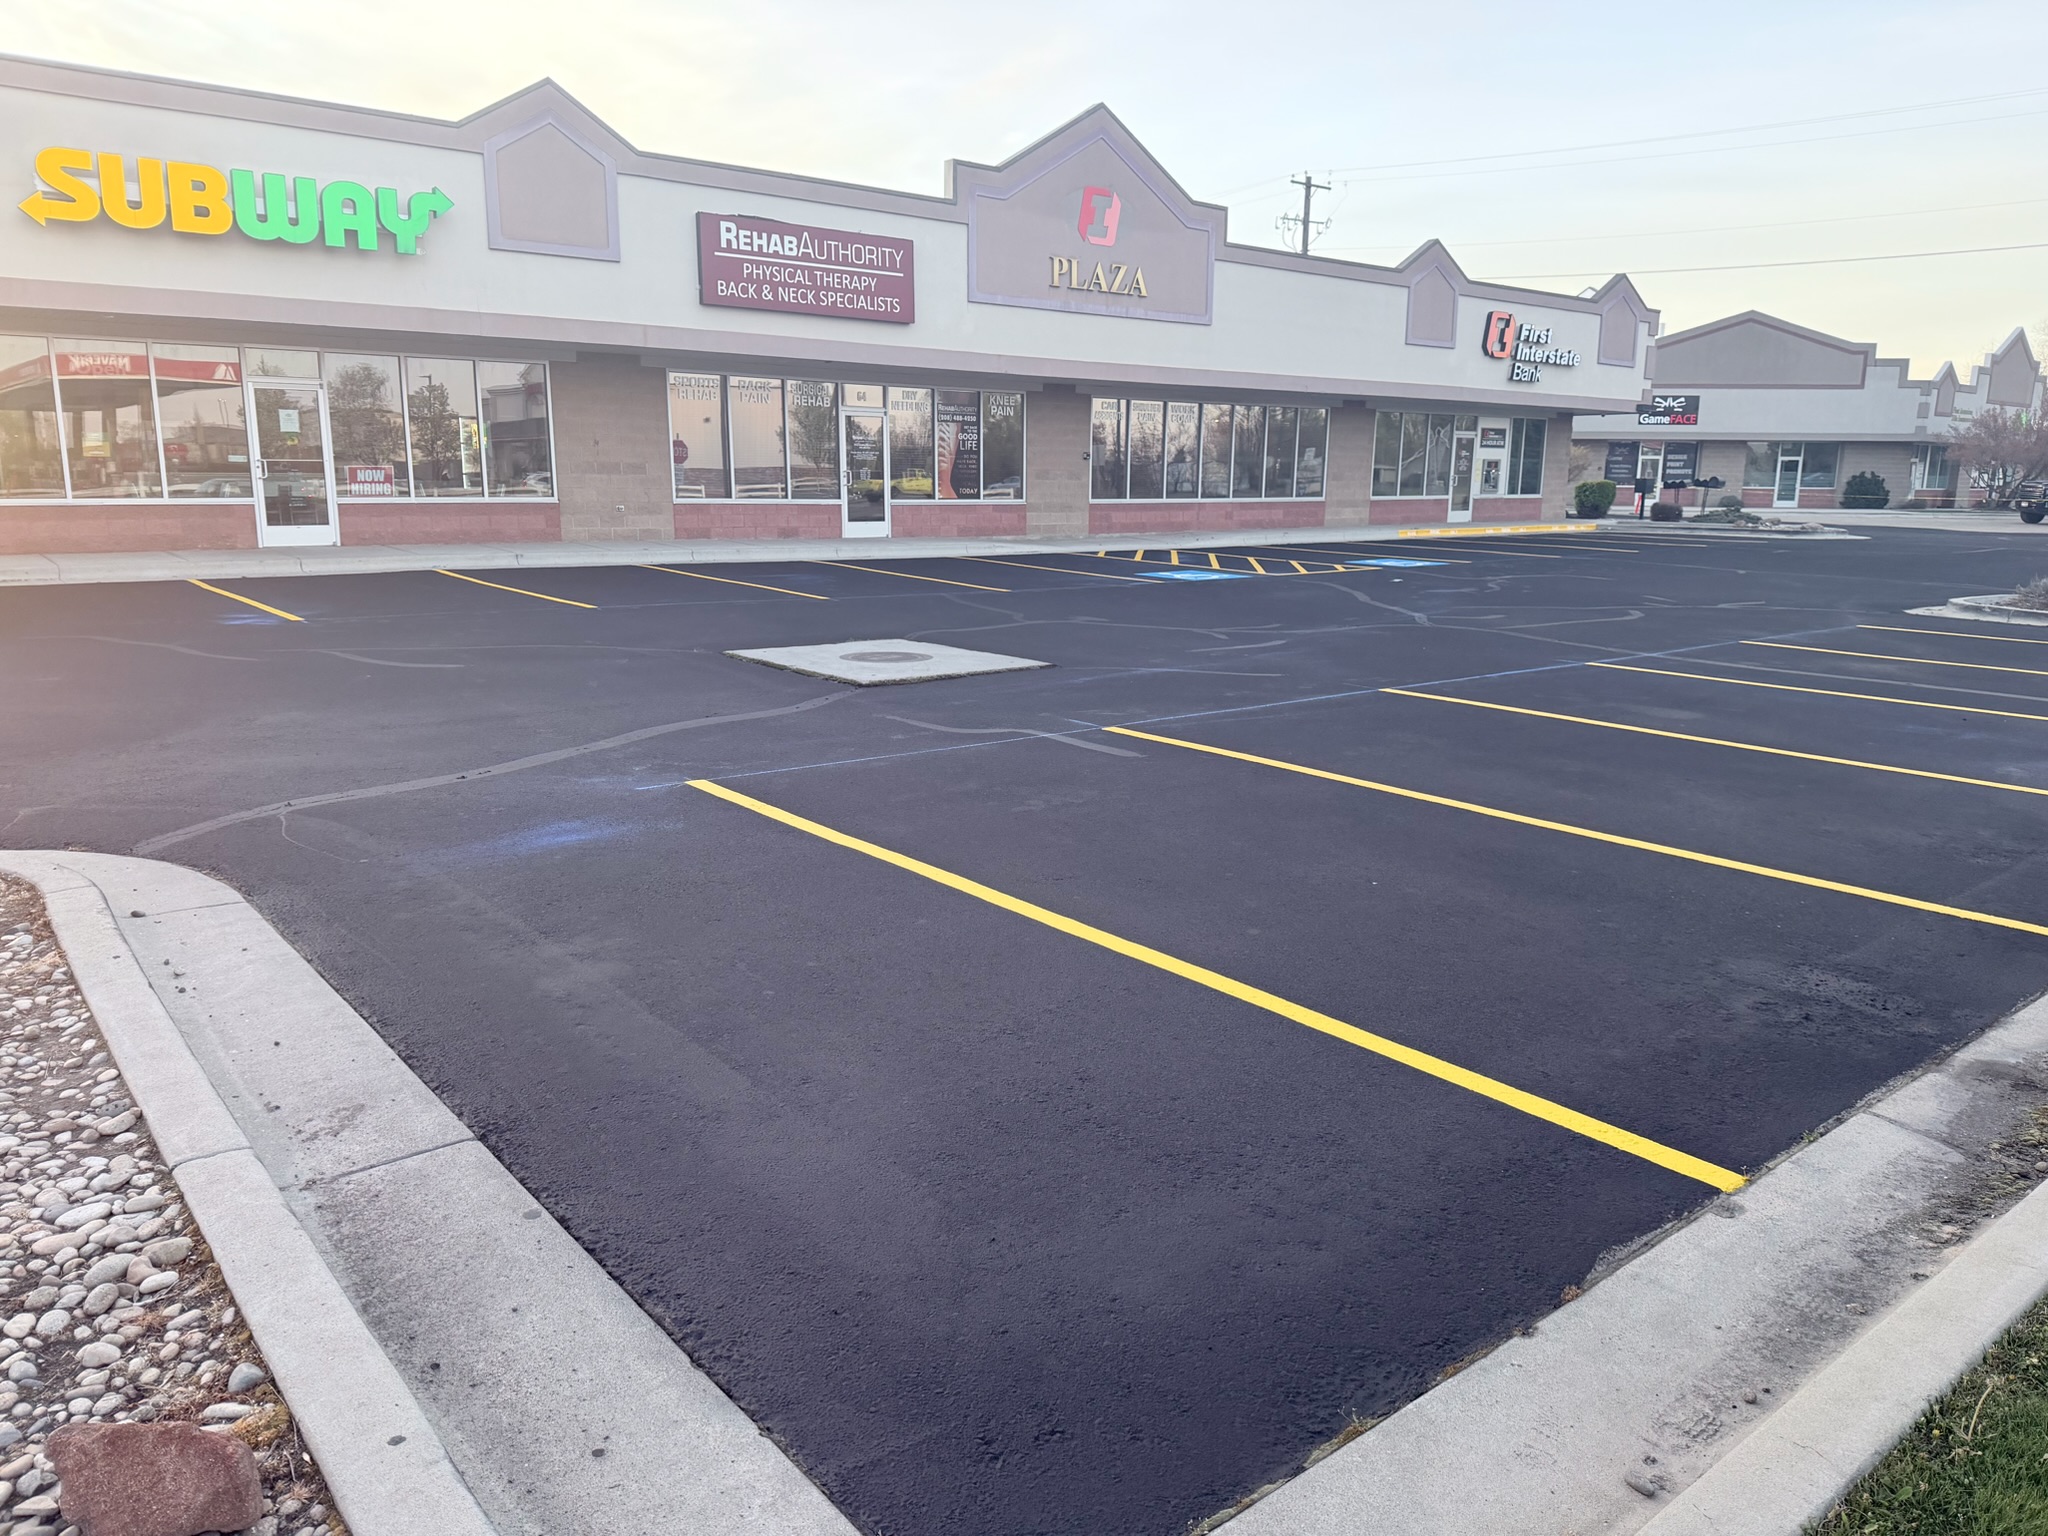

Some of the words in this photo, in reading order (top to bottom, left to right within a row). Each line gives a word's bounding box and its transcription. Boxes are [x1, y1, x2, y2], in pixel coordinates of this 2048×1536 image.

[18, 146, 455, 255] SUBWAY
[743, 263, 812, 286] PHYSICAL
[814, 271, 877, 292] THERAPY
[1049, 255, 1148, 298] PLAZA
[717, 280, 758, 300] BACK
[762, 284, 773, 301] &
[778, 286, 816, 306] NECK
[819, 290, 901, 314] SPECIALISTS
[1519, 323, 1553, 344] First
[1515, 343, 1581, 368] Interstate
[1512, 362, 1542, 383] Bank
[673, 375, 720, 389] SPORTS
[737, 379, 773, 393] BACK
[677, 388, 719, 401] REHAB
[739, 391, 771, 404] PAIN
[990, 395, 1016, 405] KNEE
[793, 395, 831, 408] REHAB
[991, 406, 1014, 416] PAIN
[1640, 413, 1697, 424] GameFACE
[960, 441, 977, 450] LIFE
[357, 469, 385, 482] NOW
[351, 482, 391, 495] HIRING
